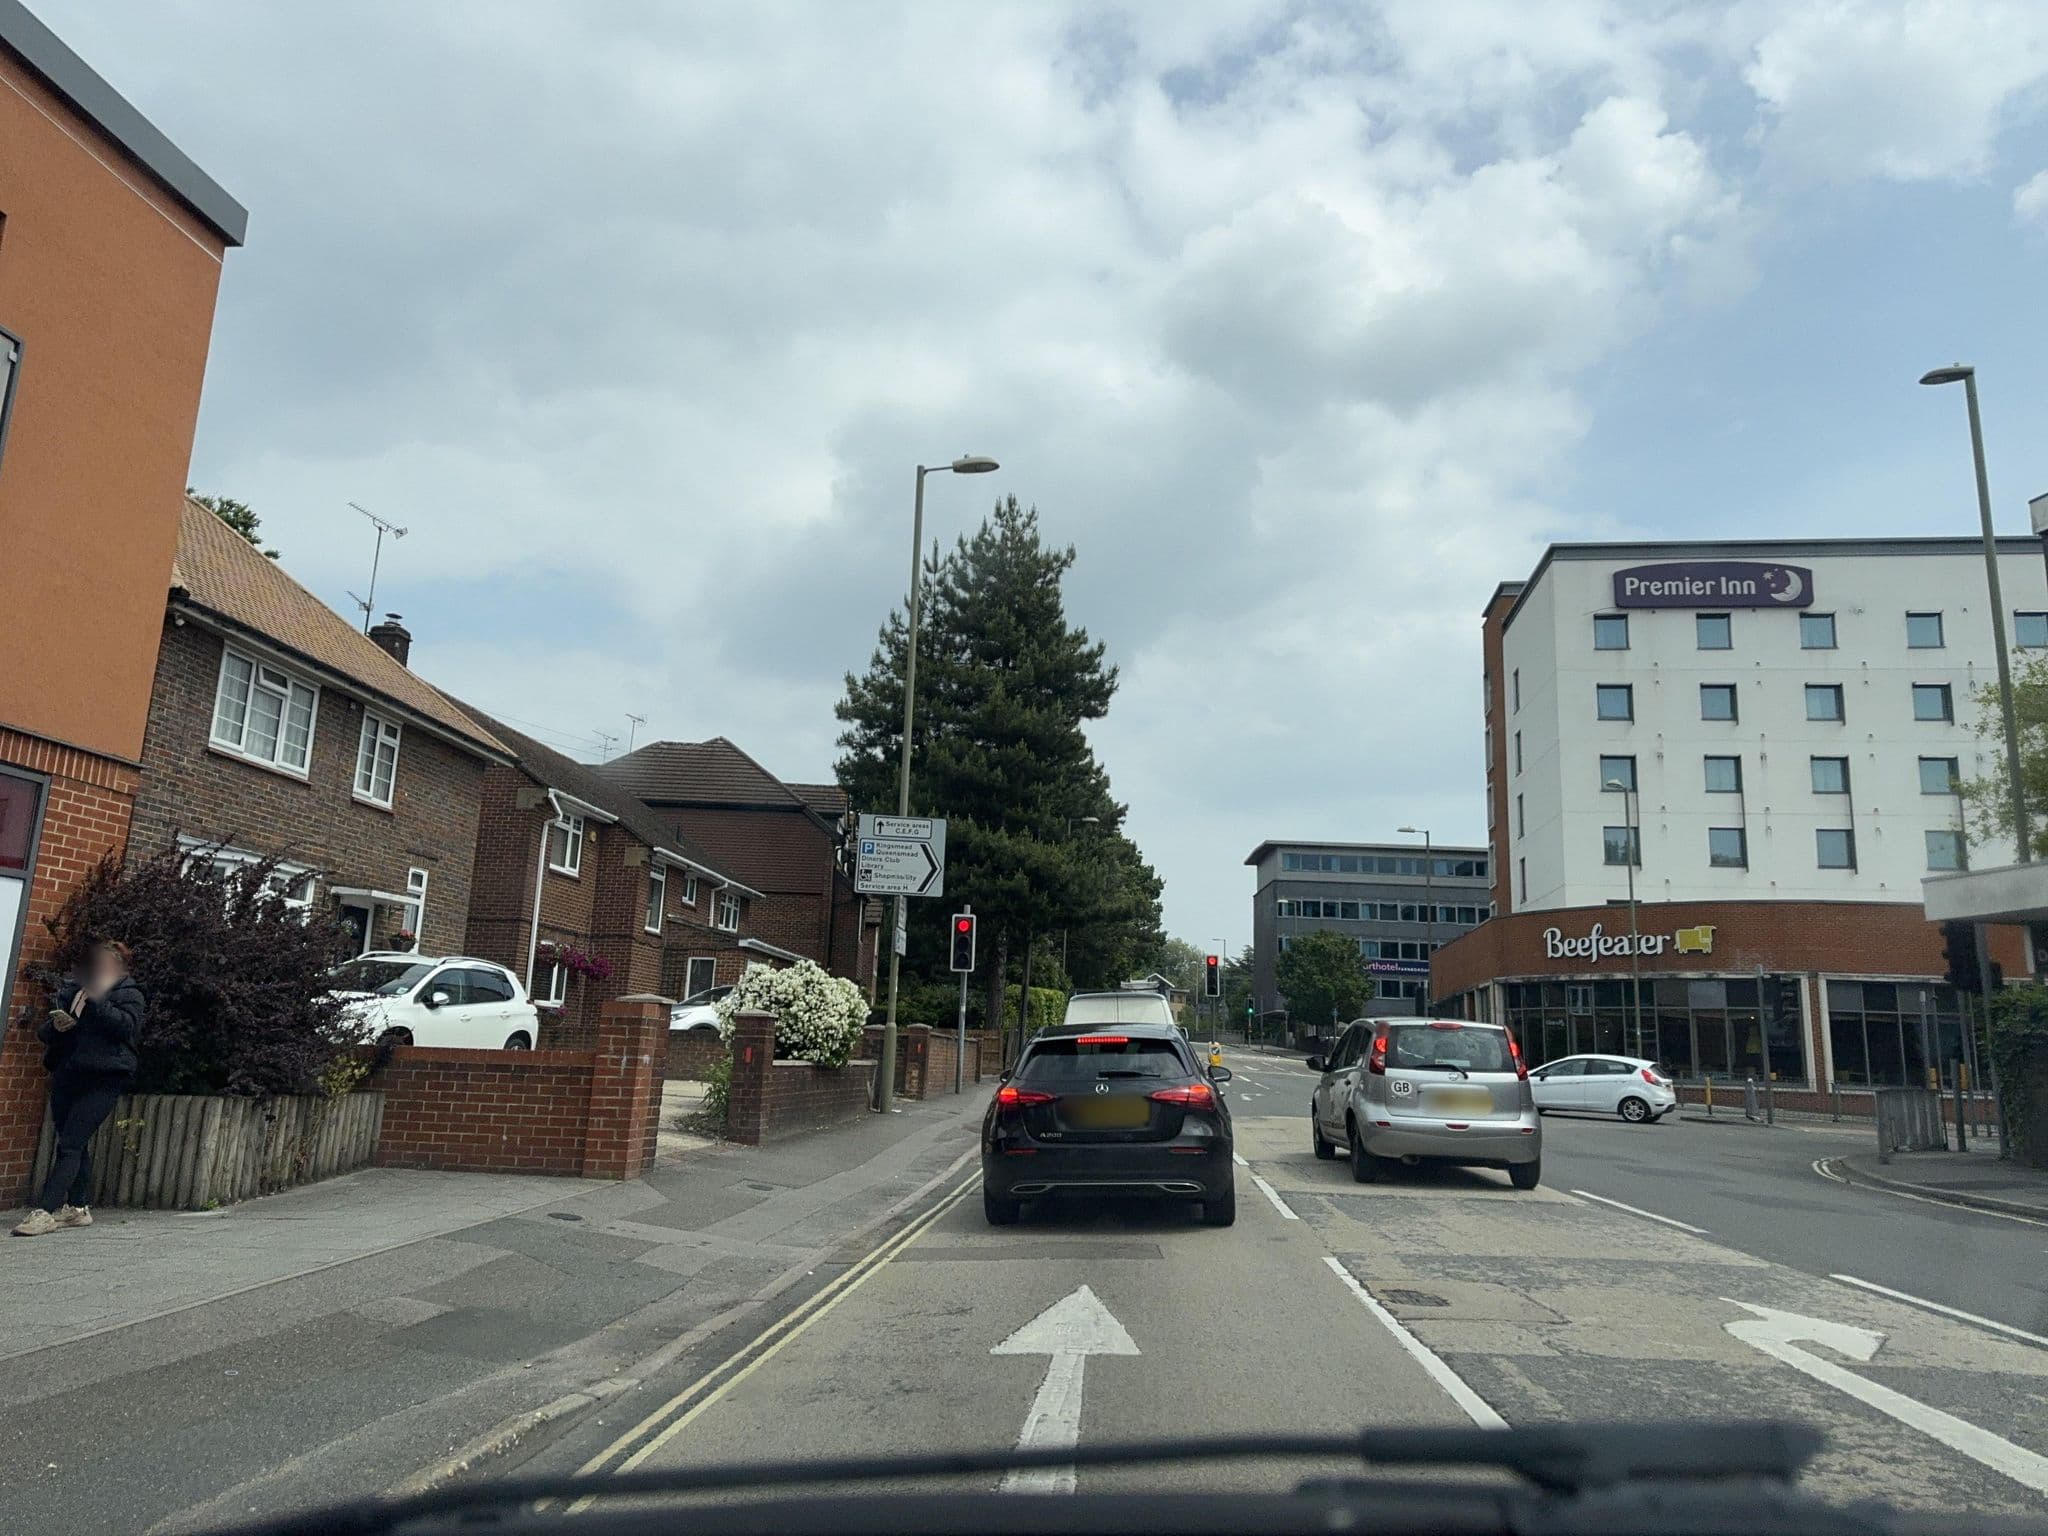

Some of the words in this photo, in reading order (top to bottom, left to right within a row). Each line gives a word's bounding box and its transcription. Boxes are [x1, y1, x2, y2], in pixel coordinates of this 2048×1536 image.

[1624, 576, 1716, 597] Premier
[1720, 576, 1756, 596] Inn
[876, 842, 912, 850] Kingsmead
[876, 849, 918, 858] Queensmead
[860, 862, 883, 870] Library
[1543, 922, 1671, 963] Beefeater
[1394, 1082, 1409, 1092] GB
